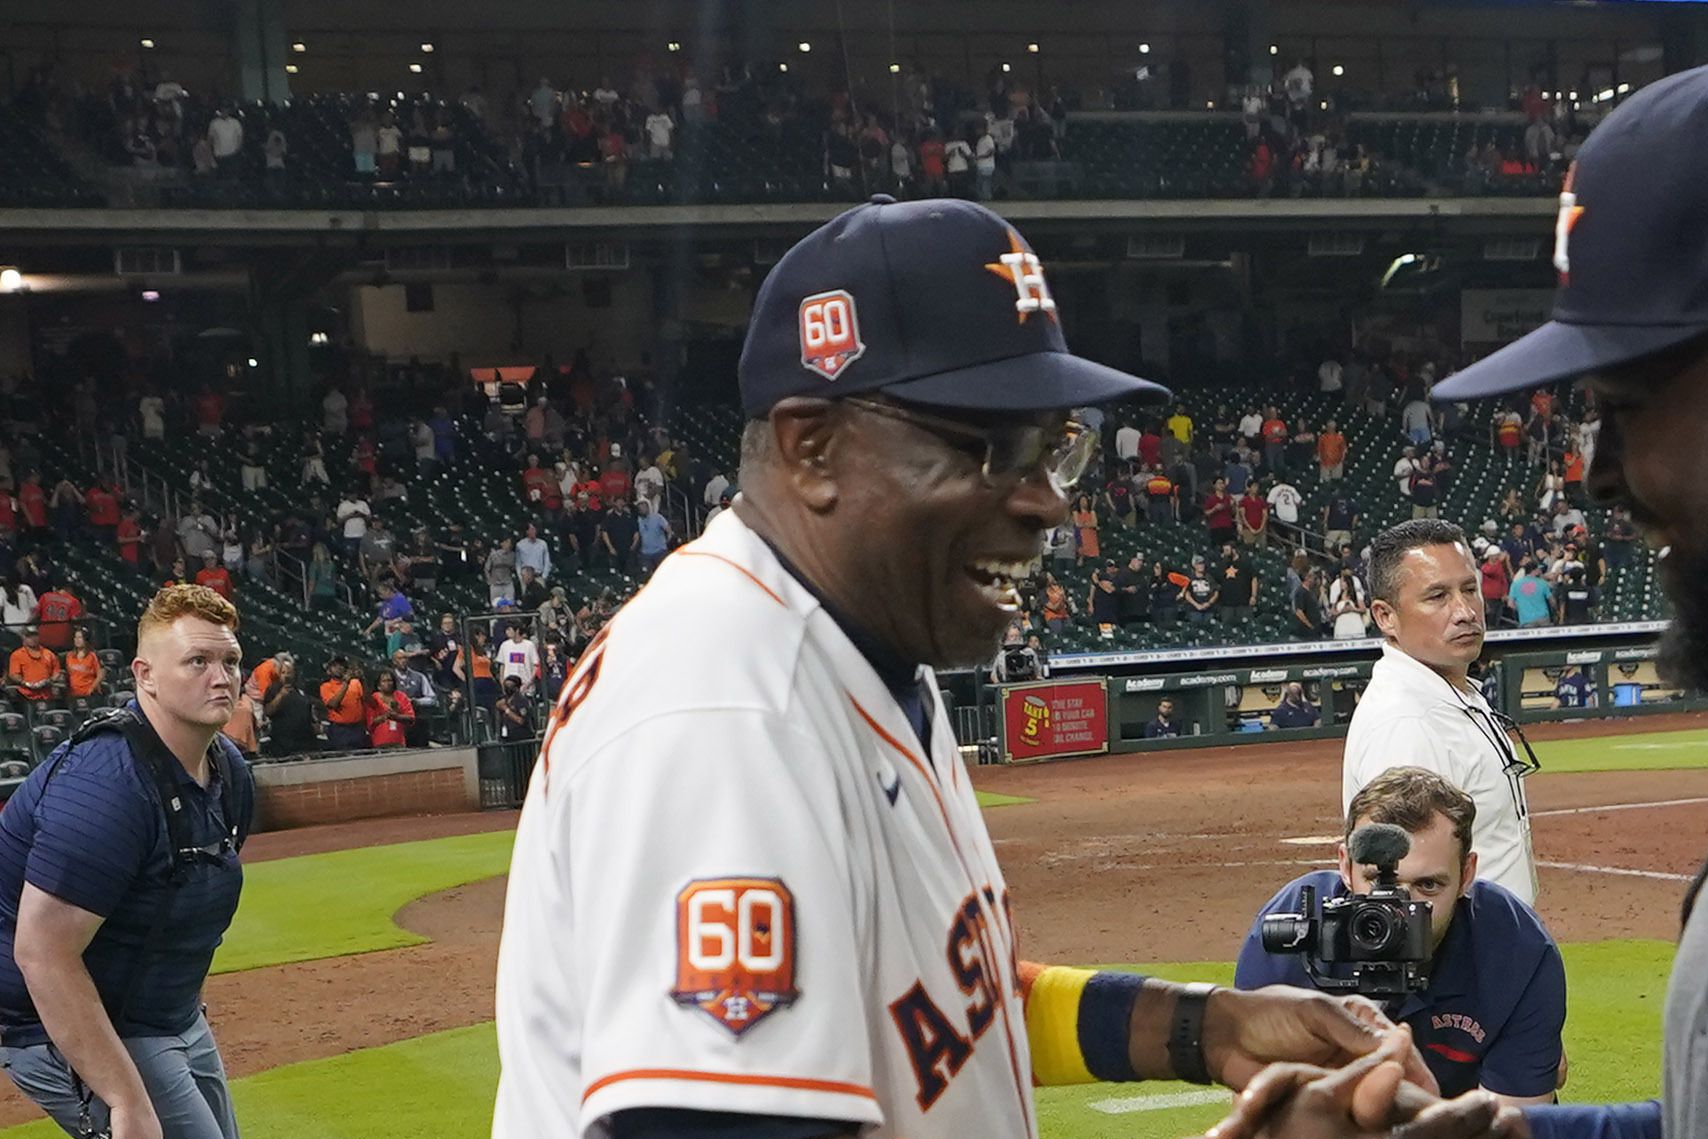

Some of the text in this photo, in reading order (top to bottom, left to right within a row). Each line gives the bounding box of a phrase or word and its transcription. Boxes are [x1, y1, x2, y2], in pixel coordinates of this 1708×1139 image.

[804, 300, 850, 347] 60
[1180, 674, 1237, 686] academy.com
[1250, 670, 1288, 683] Academy
[1303, 666, 1359, 678] academy.com
[1126, 678, 1165, 692] Academy
[1024, 717, 1038, 737] 5
[688, 889, 784, 973] 60
[1431, 1013, 1486, 1044] ASTROS
